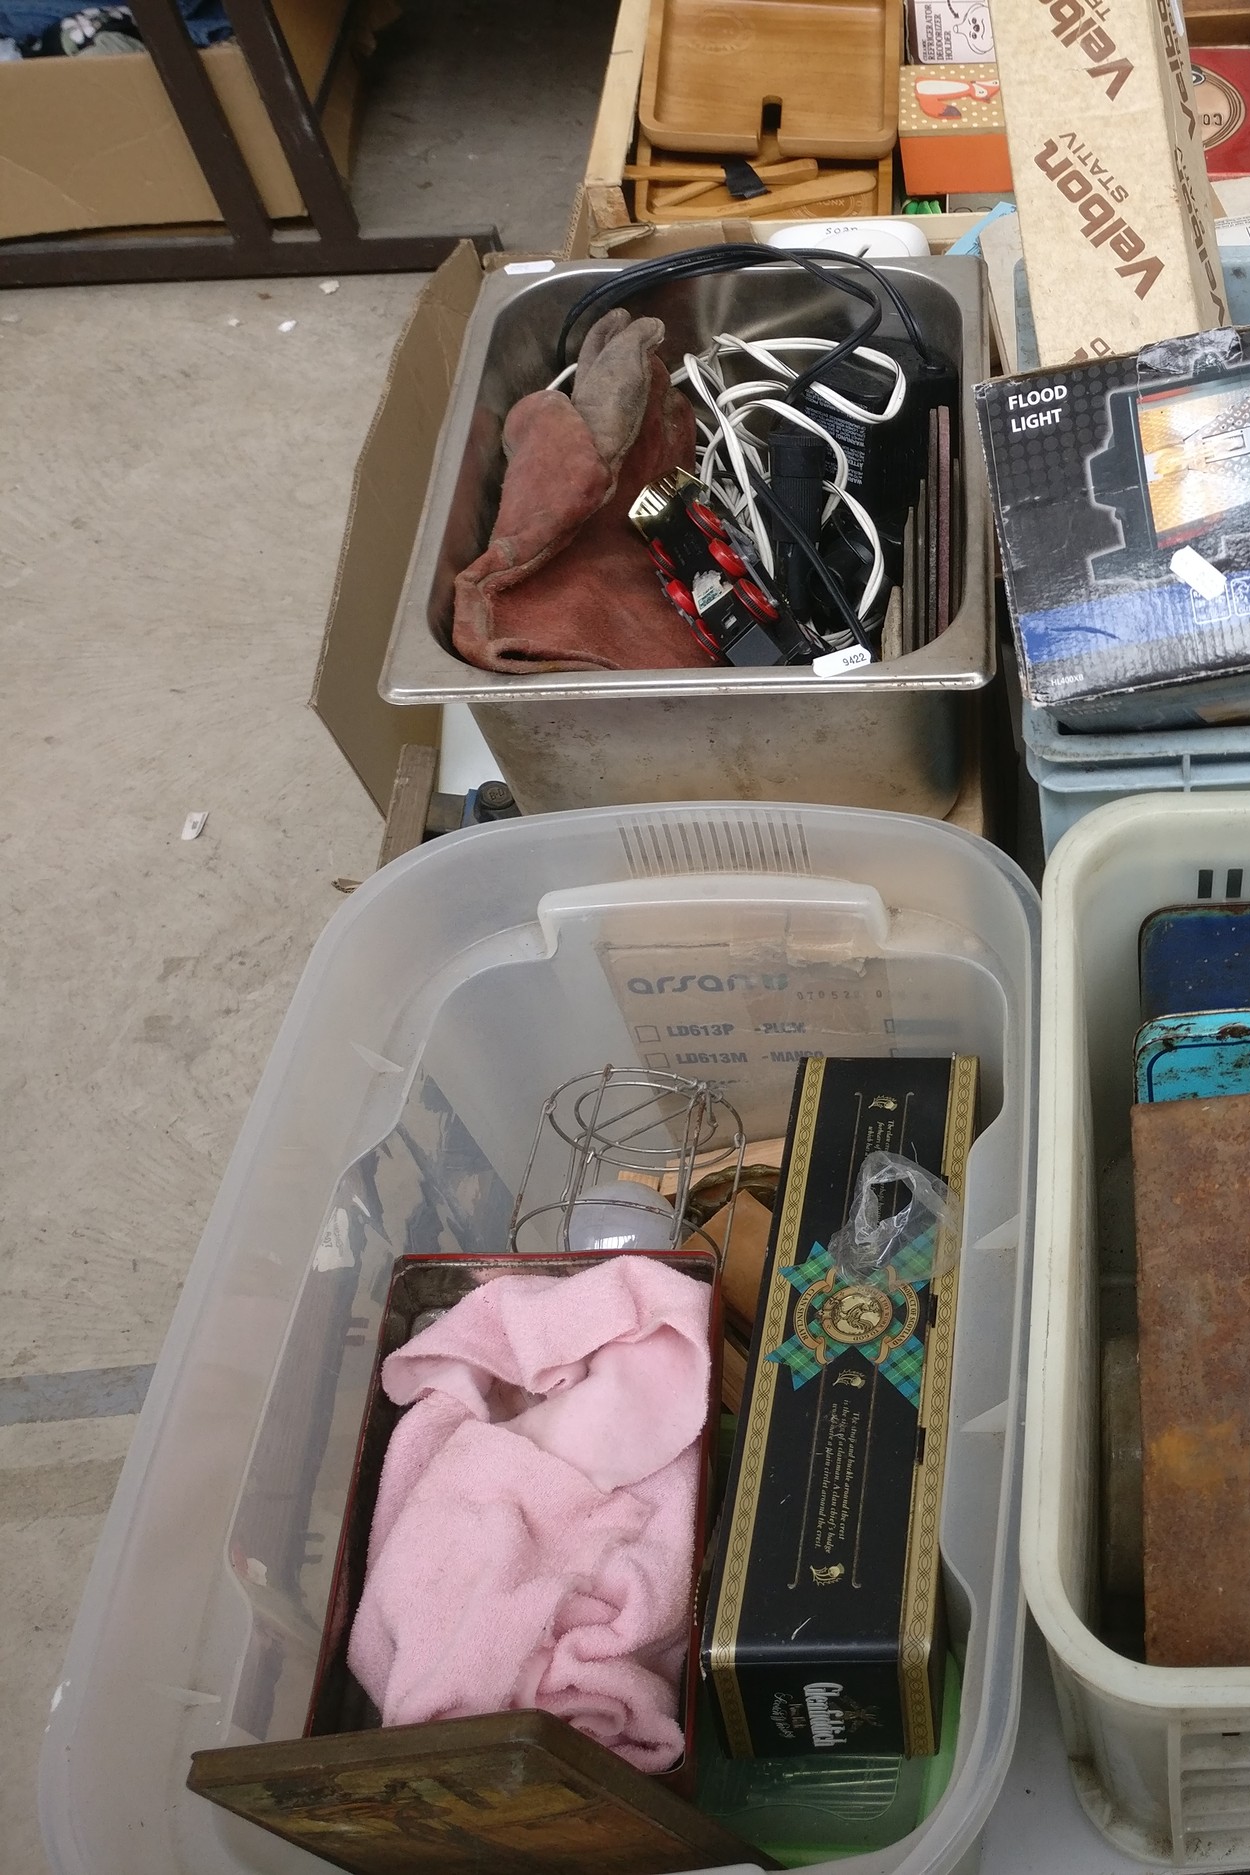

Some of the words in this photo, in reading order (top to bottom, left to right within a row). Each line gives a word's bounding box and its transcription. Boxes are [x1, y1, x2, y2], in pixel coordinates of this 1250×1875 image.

[925, 4, 935, 60] REFRIGERATOR
[934, 14, 944, 60] DEODORIZER
[944, 30, 953, 60] HOLDER
[1038, 0, 1134, 102] Velb
[1059, 132, 1130, 204] STATIV
[1034, 137, 1166, 301] Velbon
[1008, 385, 1068, 410] FLOOD
[1011, 408, 1062, 433] LIGHT
[843, 652, 867, 667] 9422
[666, 1022, 735, 1038] LD613P
[676, 1051, 749, 1065] LD613M
[892, 1319, 917, 1346] SCOTLAND
[841, 1406, 850, 1417] the
[848, 1444, 856, 1458] and
[822, 1467, 832, 1489] circlet
[846, 1459, 855, 1481] buckle
[818, 1490, 827, 1516] around
[831, 1491, 840, 1506] clan
[842, 1482, 851, 1509] around
[816, 1517, 826, 1529] the
[826, 1507, 838, 1531] chief's
[840, 1510, 849, 1521] the
[823, 1532, 836, 1554] badge
[838, 1522, 846, 1540] crest
[803, 1682, 847, 1747] Glenfiddich
